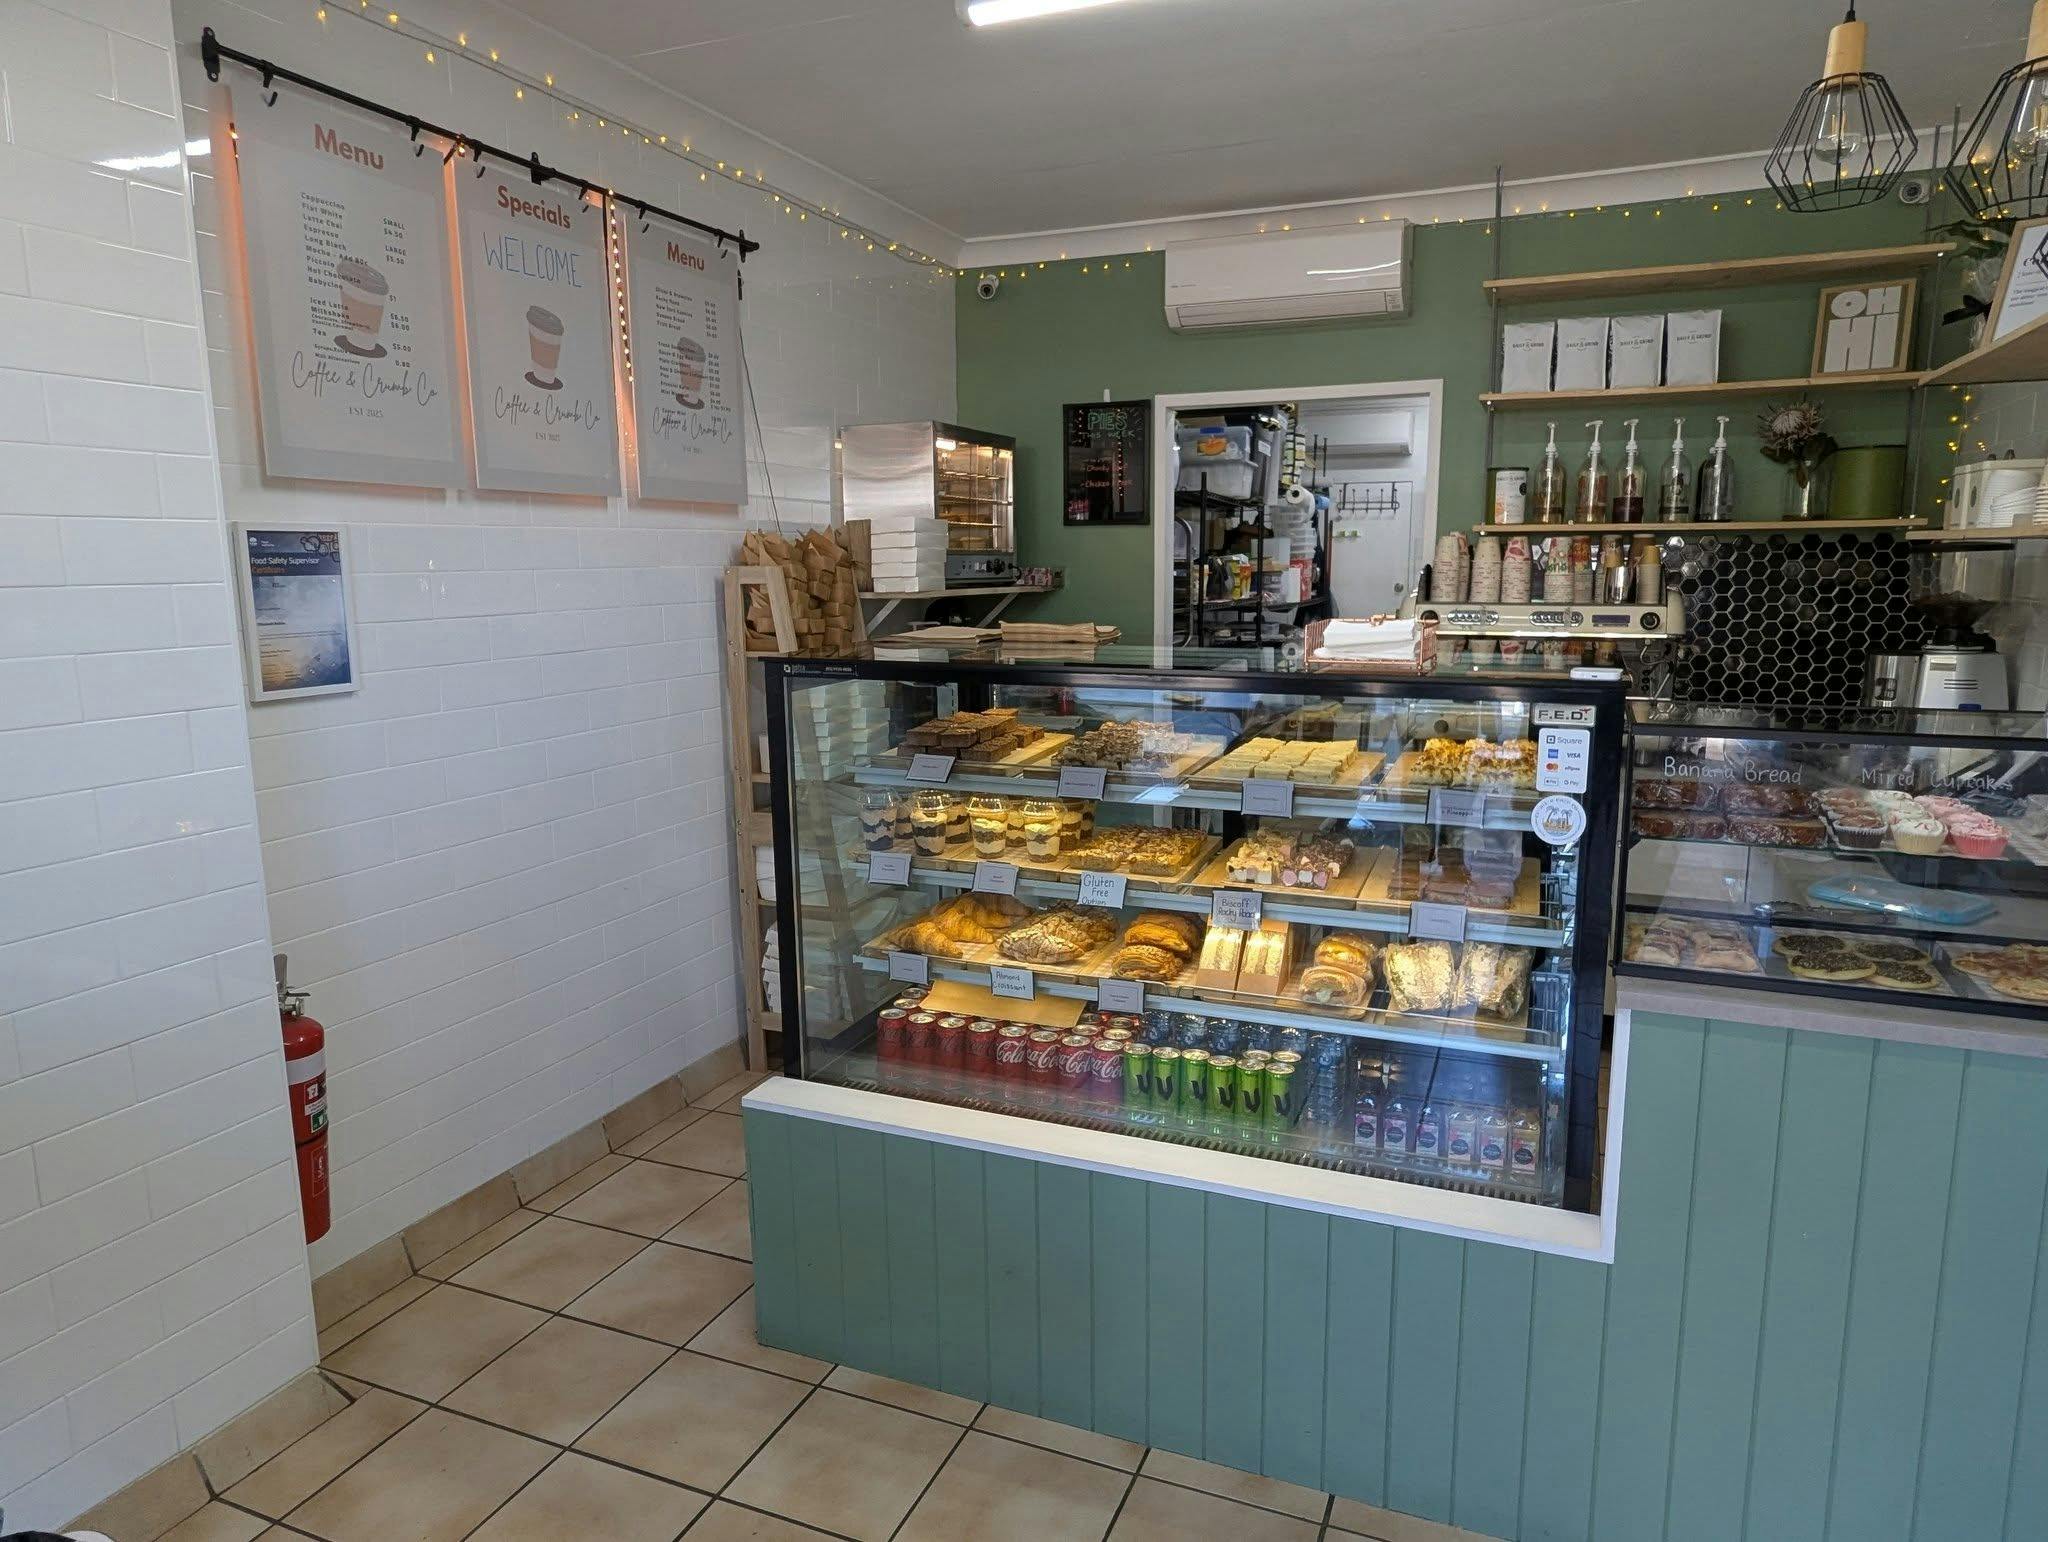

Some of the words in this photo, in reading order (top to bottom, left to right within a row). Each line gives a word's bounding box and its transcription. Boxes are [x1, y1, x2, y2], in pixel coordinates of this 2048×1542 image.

[315, 123, 384, 170] Menu
[301, 192, 345, 210] Cappuccino
[498, 184, 571, 230] Specials
[320, 208, 342, 220] White
[304, 214, 323, 224] Latte
[326, 219, 342, 230] Chai
[383, 217, 406, 230] SMALL
[304, 224, 339, 239] Espresso
[305, 235, 323, 247] Long
[326, 240, 347, 251] Black
[305, 245, 331, 256] Mocha
[385, 245, 407, 257] LARGE
[667, 240, 705, 272] Menu
[483, 231, 582, 288] WELCOME
[308, 266, 320, 276] Hot
[323, 269, 361, 284] Chocolate
[308, 276, 343, 290] Babycino
[310, 296, 326, 306] Iced
[330, 301, 348, 311] Latte
[310, 306, 350, 320] Milkshake
[312, 328, 327, 336] Tea
[292, 350, 342, 398] Coffee
[346, 370, 356, 387] &
[362, 362, 412, 399] Crumb
[417, 371, 438, 406] Co
[494, 386, 530, 426] Coffee
[533, 402, 541, 416] &
[545, 394, 582, 426] Crumb
[584, 400, 600, 431] Co
[1087, 411, 1128, 431] PIES
[268, 557, 288, 566] Safety
[288, 556, 320, 566] Supervisor
[1538, 710, 1588, 721] F.E.D.
[1557, 736, 1582, 746] Square
[1664, 756, 1736, 781] Banana
[1744, 760, 1803, 785] Bread
[1862, 767, 1915, 786] Mixed
[1084, 874, 1115, 888] Gluten
[1092, 887, 1109, 898] Free
[1222, 898, 1250, 908] Biscoff
[996, 970, 1020, 981] Almond
